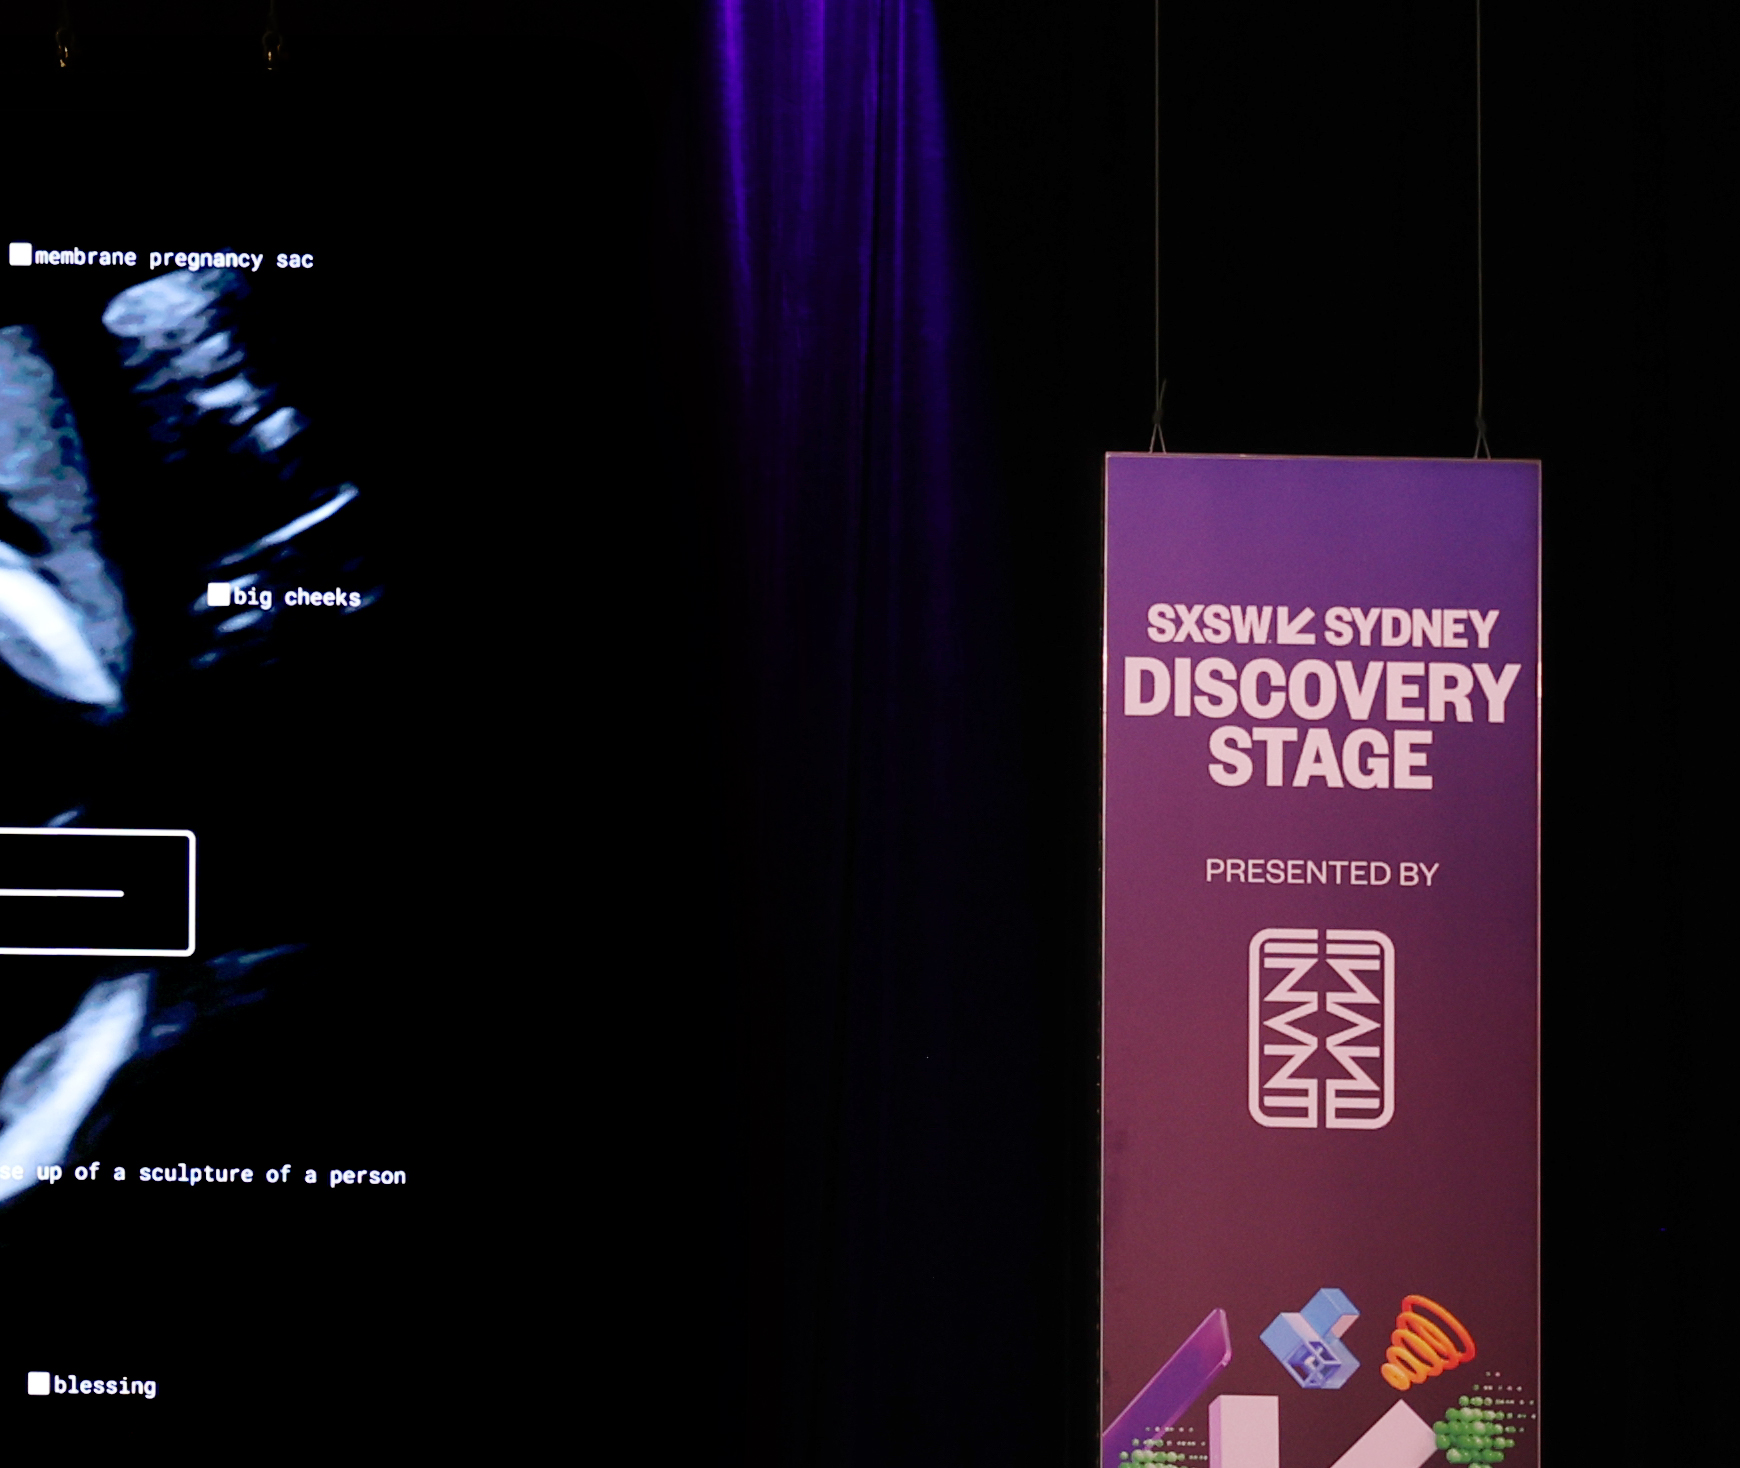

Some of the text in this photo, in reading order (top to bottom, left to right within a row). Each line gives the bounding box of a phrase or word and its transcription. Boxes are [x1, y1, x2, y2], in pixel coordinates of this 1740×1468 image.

[34, 246, 314, 271] membrane pregnancy sac
[233, 584, 362, 611] big cheeks
[1146, 602, 1500, 649] SXSW SYDNEY
[1123, 656, 1523, 724] DISCOVERY
[1208, 725, 1434, 790] STAGE
[1206, 858, 1440, 887] PRESENTED BY
[37, 1164, 63, 1185] up
[74, 1161, 100, 1181] of
[113, 1166, 126, 1181] a
[139, 1162, 254, 1186] sculpture
[266, 1164, 292, 1183] of
[304, 1169, 317, 1184] a
[330, 1169, 406, 1188] person
[54, 1374, 157, 1400] blessing
